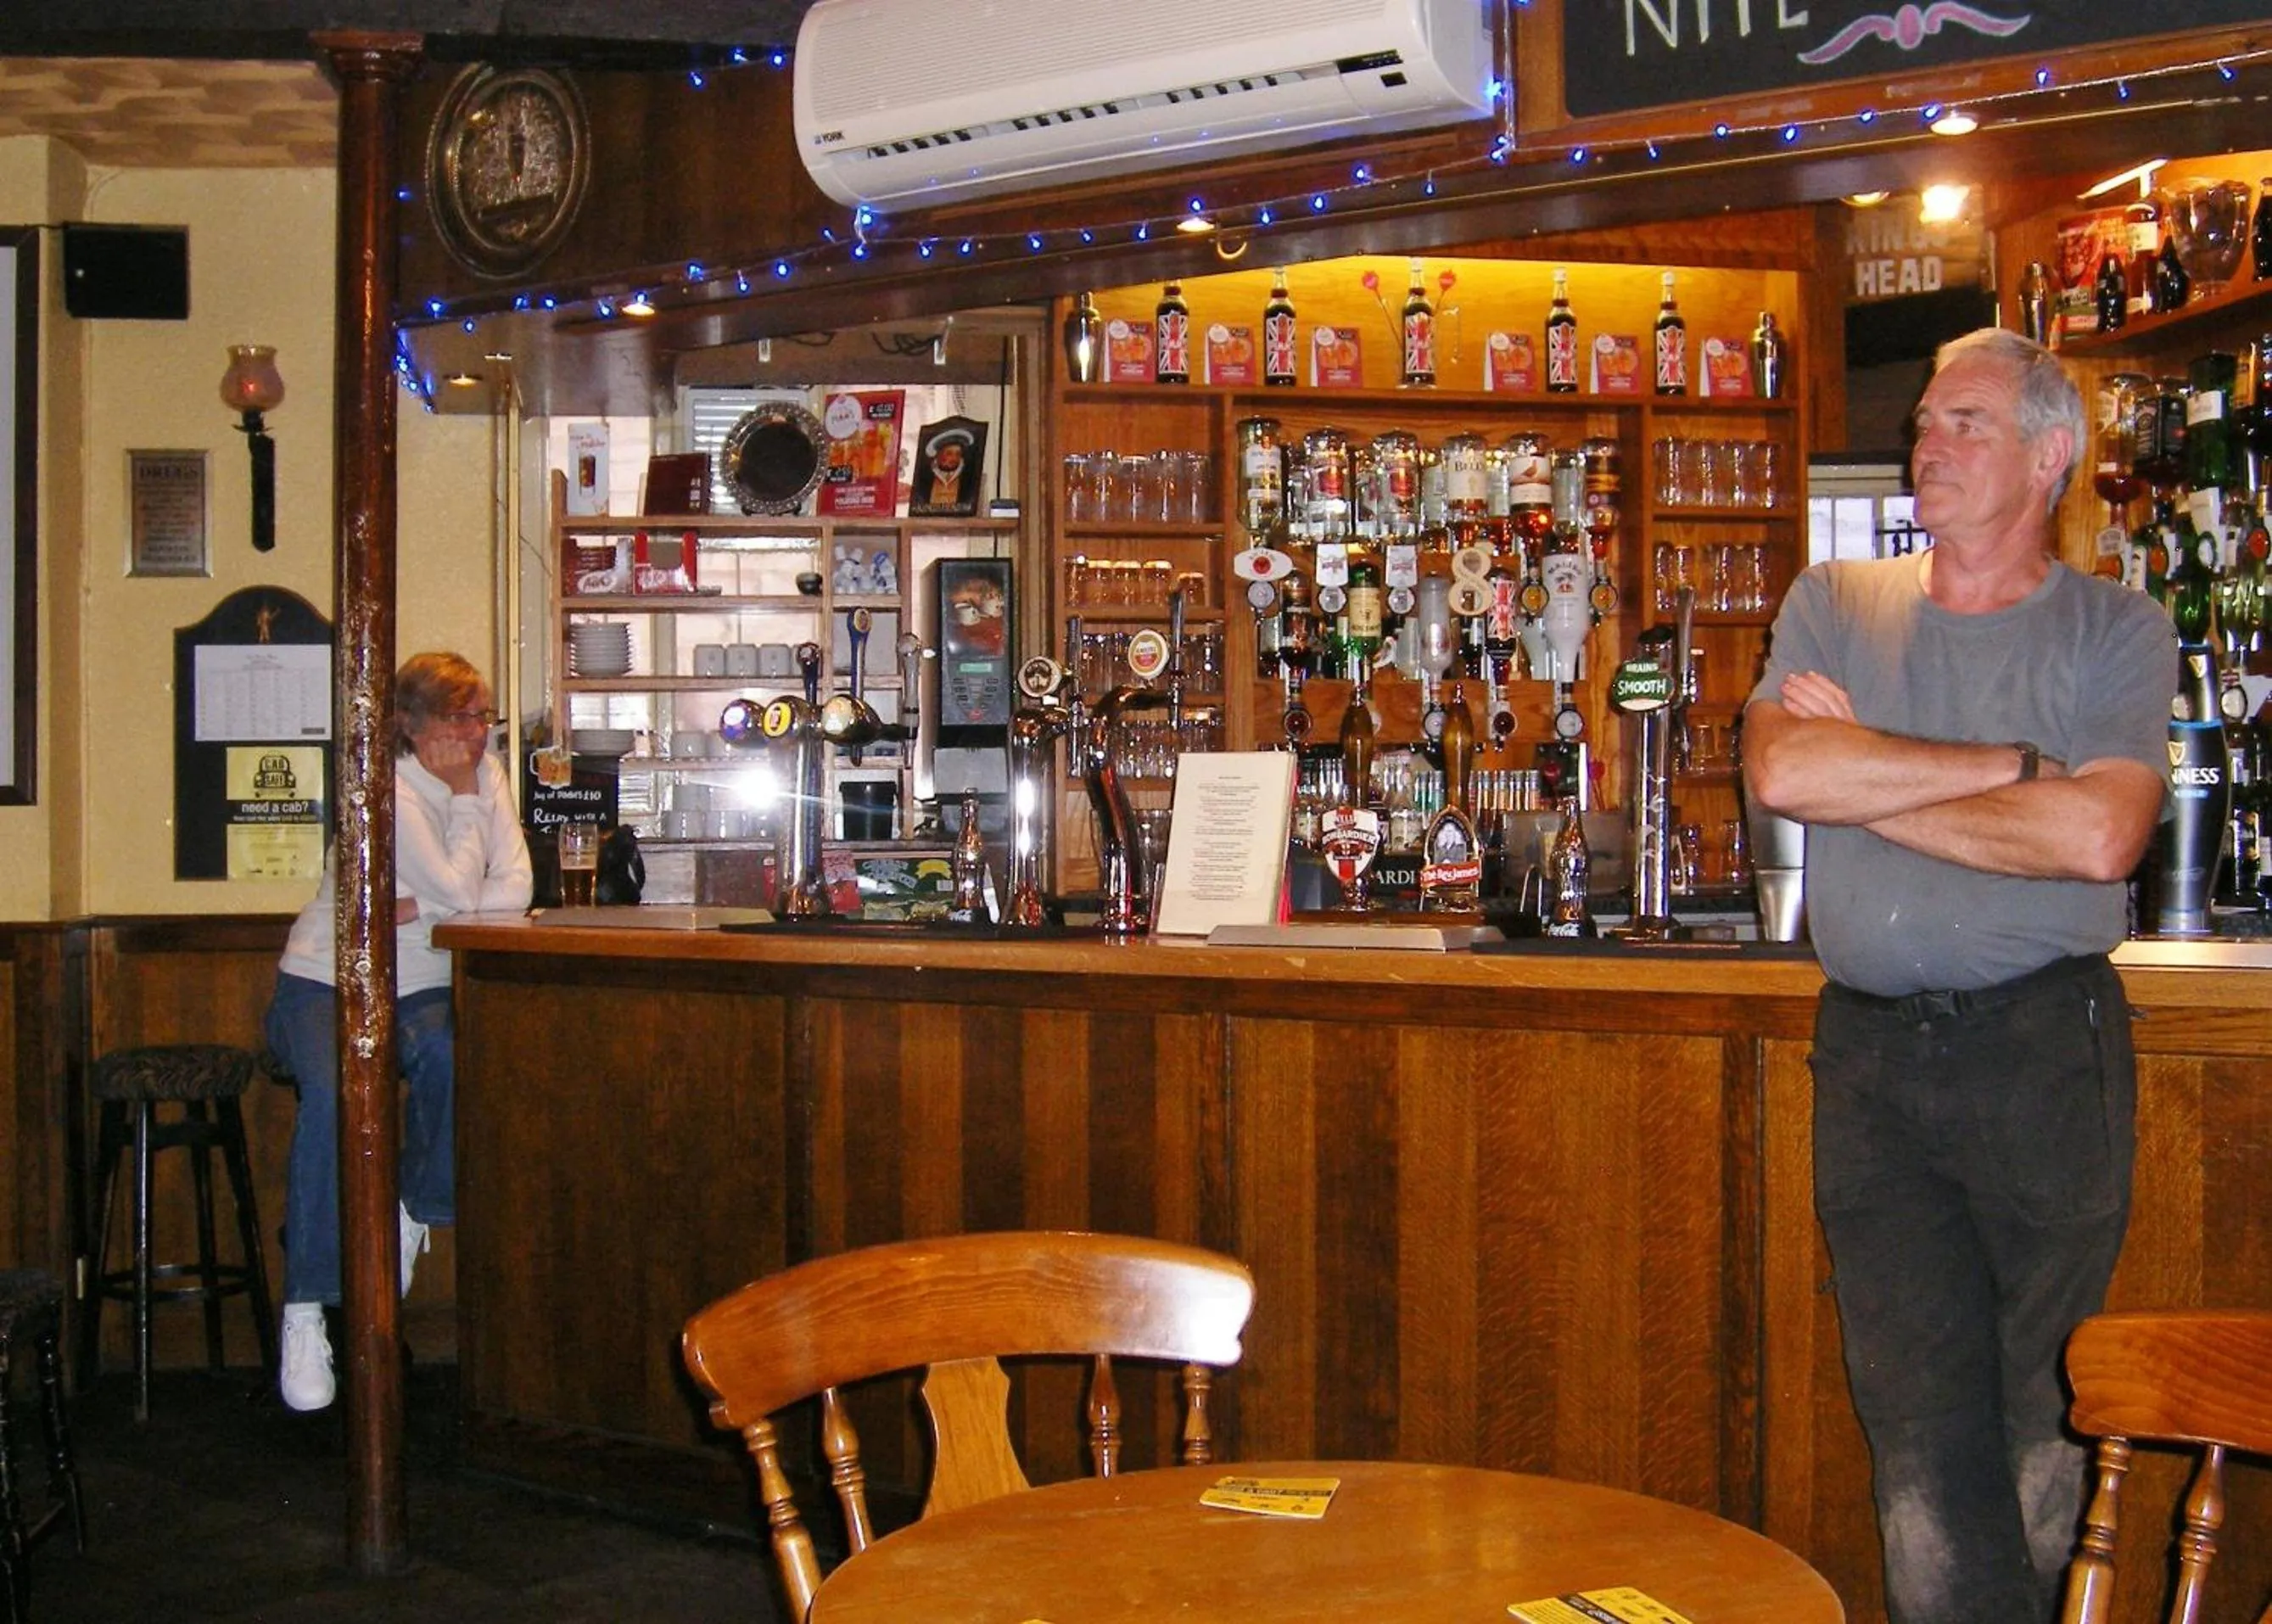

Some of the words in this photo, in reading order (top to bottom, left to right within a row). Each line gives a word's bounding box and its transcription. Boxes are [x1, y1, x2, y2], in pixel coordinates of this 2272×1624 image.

[1855, 256, 1942, 296] HEAD
[1618, 678, 1667, 695] SMOOTH
[265, 759, 285, 771] CAB
[2172, 767, 2220, 785] NNESS
[242, 803, 269, 813] need
[271, 804, 279, 813] a
[282, 801, 309, 813] cab?
[599, 812, 607, 822] A
[1376, 871, 1414, 884] ARDI
